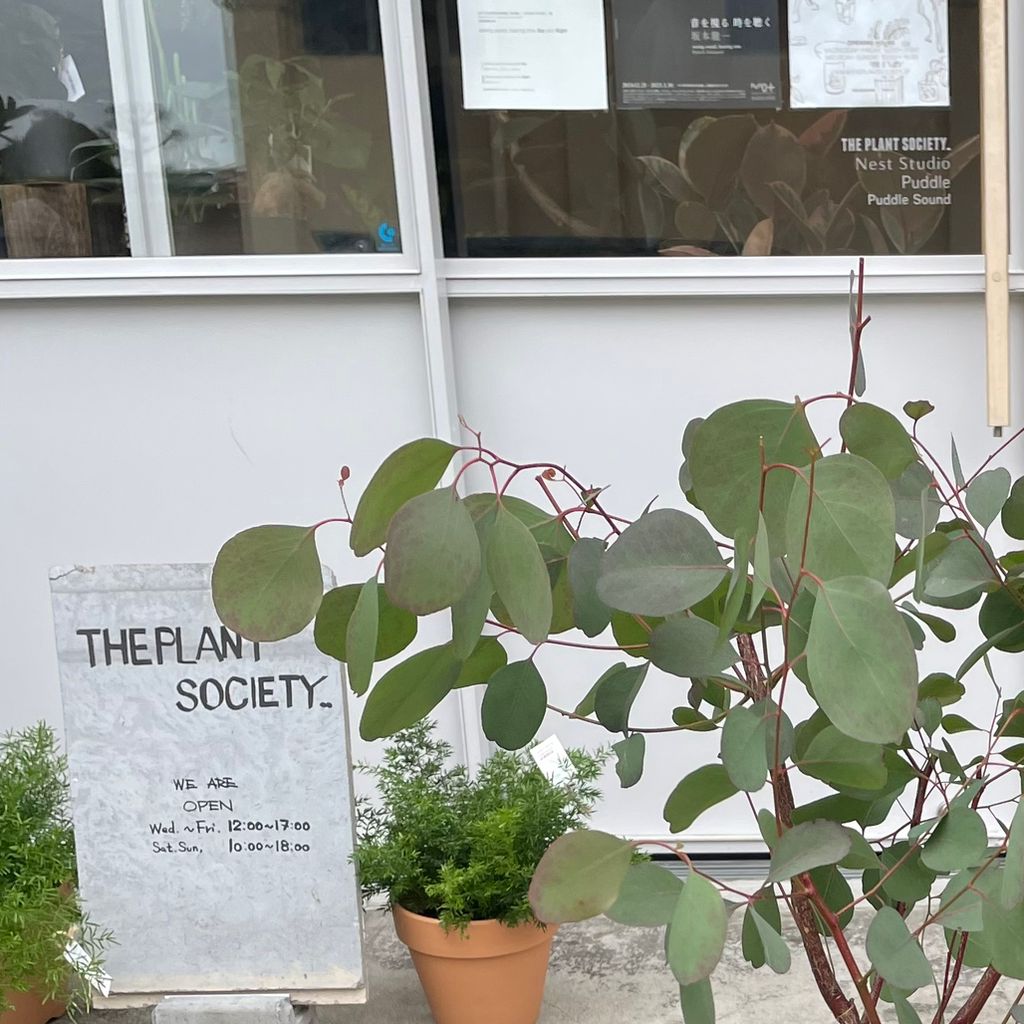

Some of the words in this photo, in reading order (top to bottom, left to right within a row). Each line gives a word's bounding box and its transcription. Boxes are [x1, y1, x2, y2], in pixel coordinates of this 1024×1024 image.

[841, 138, 862, 152] THE
[864, 137, 900, 152] PLANT
[855, 157, 893, 170] Nest
[899, 156, 951, 170] Studio
[901, 175, 951, 189] Puddle
[867, 194, 909, 206] Puddle
[912, 193, 952, 206] Sound
[173, 778, 198, 791] WE
[207, 777, 238, 790] ARE
[183, 799, 234, 813] OPEN
